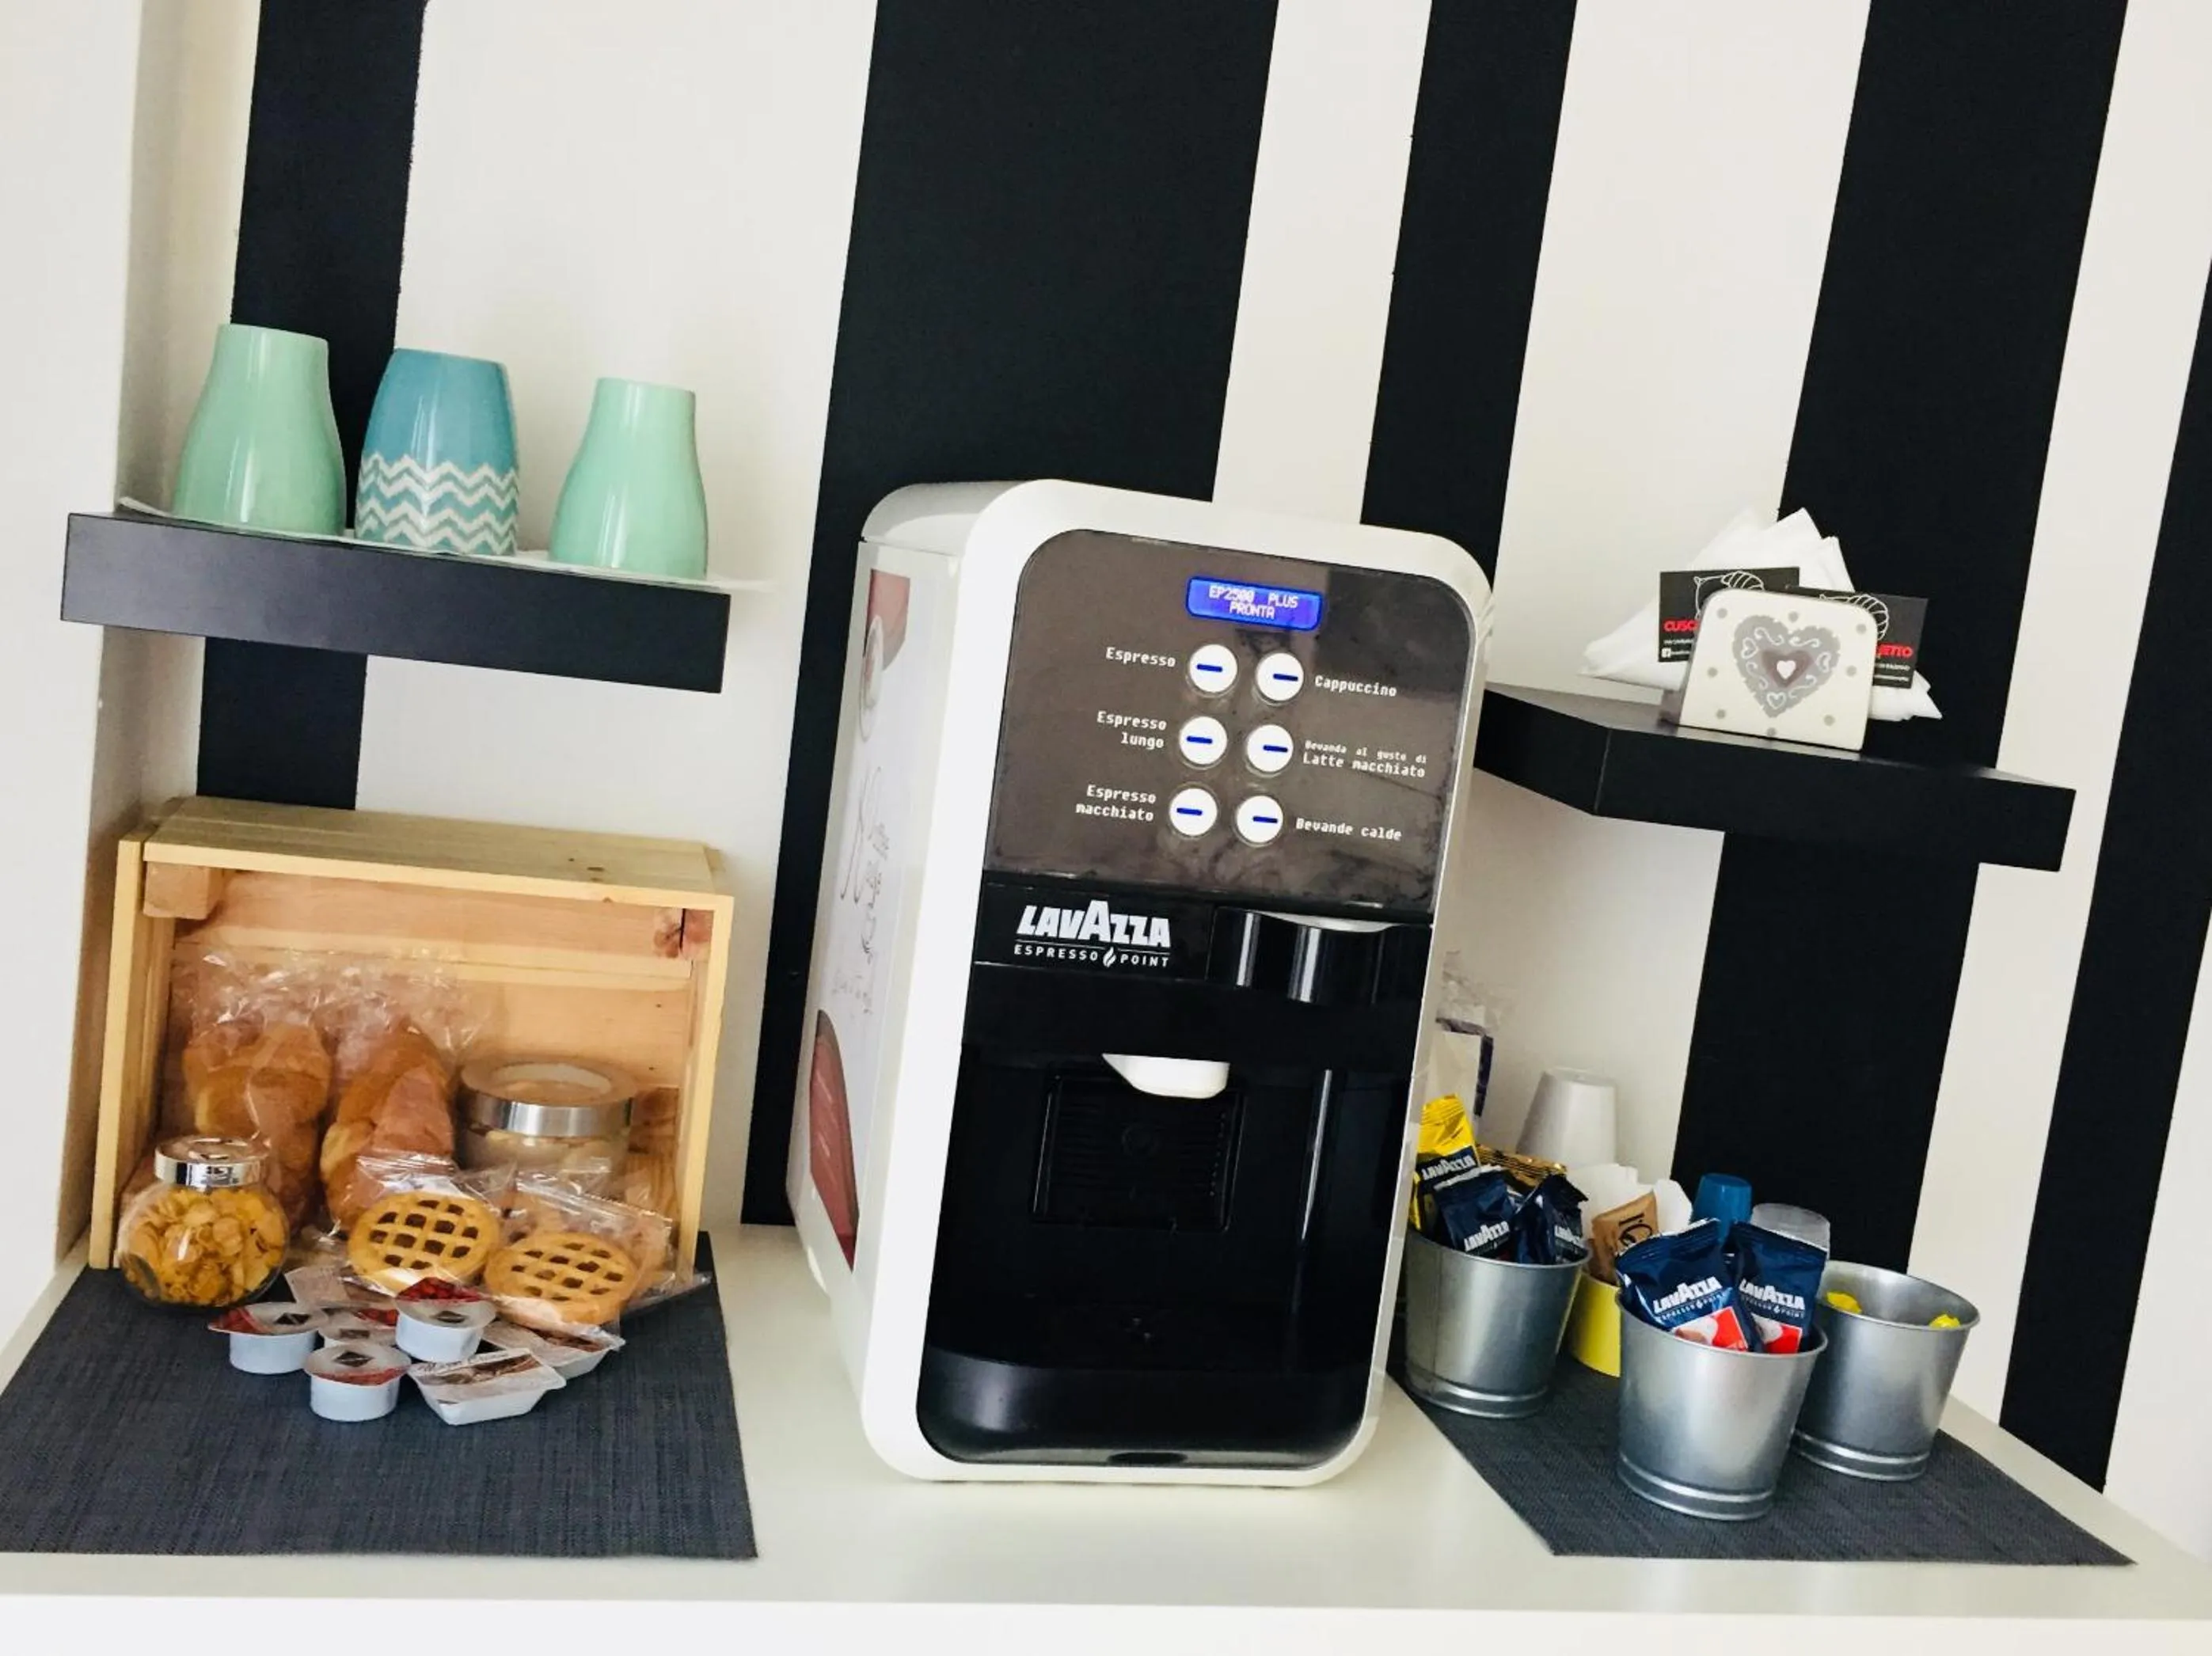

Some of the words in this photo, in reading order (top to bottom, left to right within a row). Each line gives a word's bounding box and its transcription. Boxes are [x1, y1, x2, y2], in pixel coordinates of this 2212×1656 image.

[1229, 600, 1275, 620] PRONTA
[1268, 591, 1299, 609] PLUS
[1105, 646, 1176, 667] Espresso
[1314, 674, 1397, 697] Cappuccino
[1096, 709, 1168, 731] Espresso
[1120, 731, 1165, 750] lungo
[1305, 739, 1347, 754] Bevanda
[1376, 750, 1408, 762] gusto
[1415, 754, 1427, 765] di
[1302, 751, 1345, 768] Latte
[1351, 759, 1426, 778] macchiato
[1086, 784, 1157, 804] Espresso
[1075, 803, 1154, 822] macchiato
[1295, 817, 1354, 836] Bevande
[1360, 826, 1403, 842] calde
[1016, 898, 1172, 949] LAVAZZA
[1013, 944, 1099, 962] ESPRESSO
[1119, 953, 1170, 969] POINT
[1421, 1154, 1477, 1182] LAVAZZA
[1463, 1220, 1511, 1252] LAVAZZA
[1652, 1275, 1724, 1315] LAVAZZA
[1739, 1278, 1806, 1311] LAVAZZA
